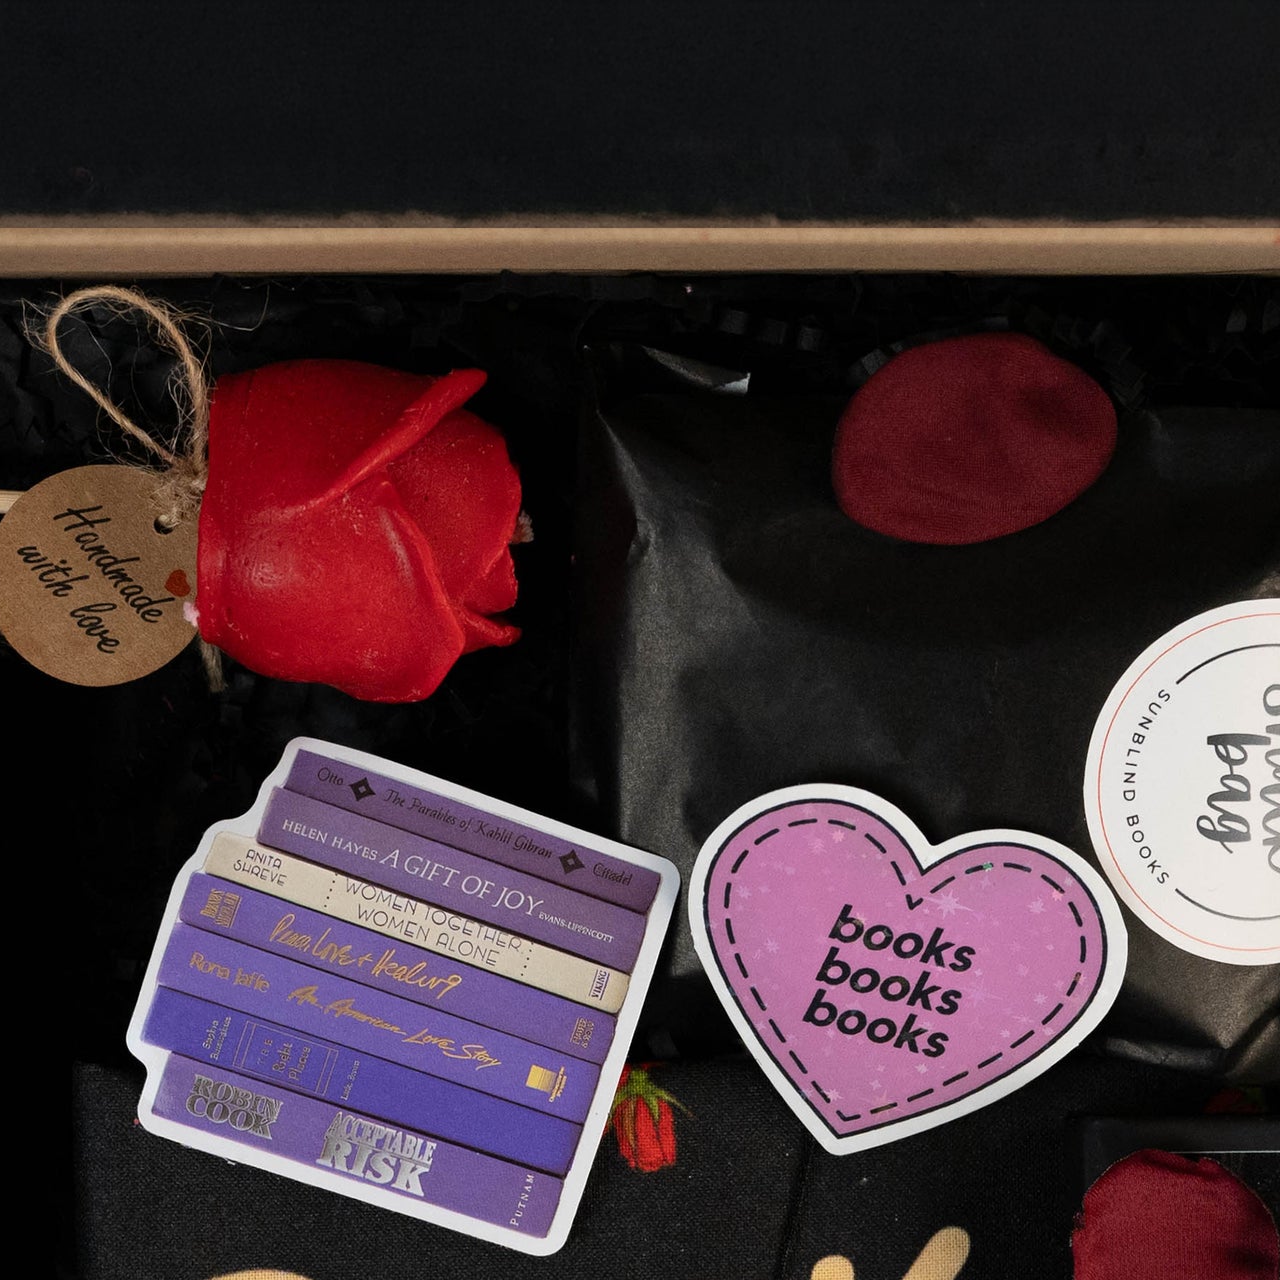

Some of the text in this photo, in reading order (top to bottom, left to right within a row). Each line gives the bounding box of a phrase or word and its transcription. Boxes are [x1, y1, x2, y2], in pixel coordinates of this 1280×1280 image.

[53, 505, 175, 623] Handmade
[17, 545, 120, 654] with love
[1123, 688, 1171, 885] SUNBLIND BOOKS
[1196, 733, 1271, 854] bag
[317, 767, 633, 886] Otto The Parables of Kahlil Gibran Citadel
[233, 859, 287, 887] SHREVE
[246, 849, 283, 870] ANITA
[282, 819, 329, 843] HELEN
[332, 836, 378, 861] HAYES
[379, 849, 401, 869] A
[404, 855, 460, 888] GIFT
[461, 875, 496, 901] OF
[492, 884, 544, 916] JOY
[345, 877, 524, 950] WOMEN TOGETHER
[357, 903, 501, 967] WOMEN ALONE
[829, 904, 976, 971] books
[189, 951, 270, 993] Rona Jaffe
[591, 970, 608, 998] VIKING
[815, 947, 963, 1015] books
[802, 989, 949, 1058] books
[186, 1094, 277, 1140] COOK
[194, 1074, 284, 1122] ROBIN
[316, 1135, 431, 1197] RISK
[325, 1111, 437, 1167] ACCEPTABLE
[510, 1174, 535, 1226] PUTNAM
